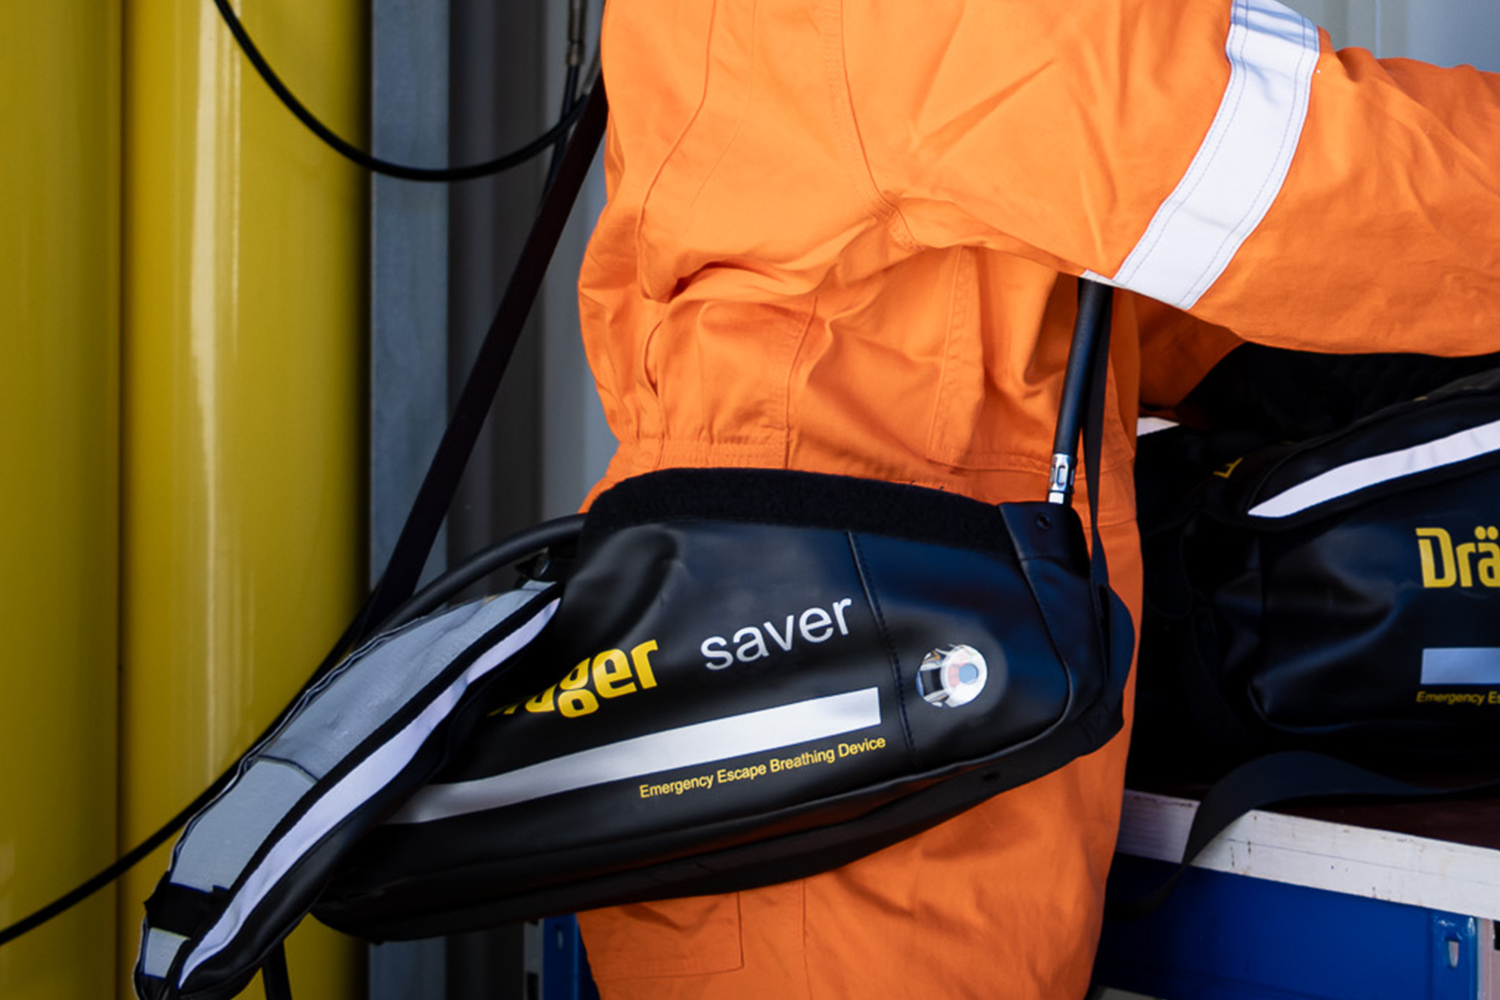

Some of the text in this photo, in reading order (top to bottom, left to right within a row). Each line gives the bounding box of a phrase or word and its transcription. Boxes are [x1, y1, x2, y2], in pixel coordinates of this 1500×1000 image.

[700, 597, 852, 671] saver
[1416, 691, 1485, 706] Emergency
[639, 735, 886, 798] Emergency Escape Breathing Device
